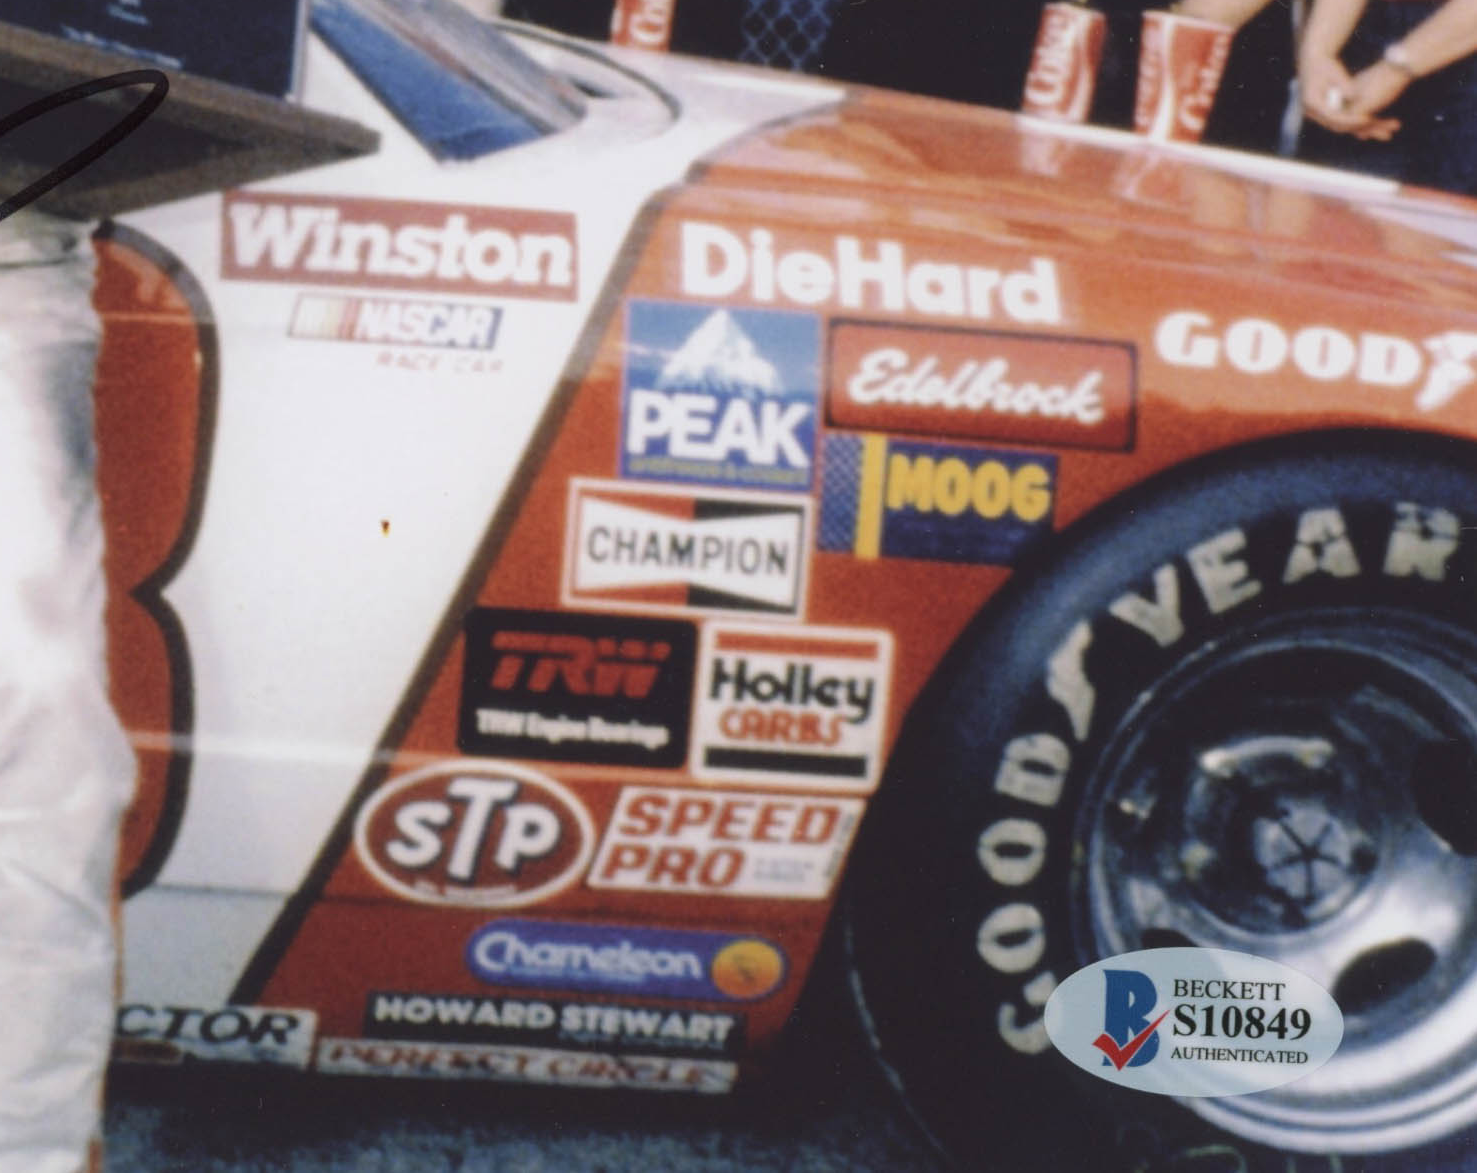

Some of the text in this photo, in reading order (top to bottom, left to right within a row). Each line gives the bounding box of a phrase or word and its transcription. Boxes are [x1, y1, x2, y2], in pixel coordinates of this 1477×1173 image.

[228, 202, 574, 287] Winston
[680, 221, 1062, 324] DieHard
[352, 300, 497, 348] NASCAR
[847, 348, 1105, 424] Edelbrock
[627, 389, 812, 469] PEAK
[886, 453, 1051, 522] MOOG
[587, 525, 789, 576] CHAMPION
[491, 631, 671, 698] TRW
[709, 657, 875, 724] Holley
[721, 709, 848, 747] CARBS
[386, 778, 561, 882] STP
[620, 792, 842, 845] SPEED
[602, 844, 746, 889] PRO
[473, 931, 704, 981] Chameleon
[374, 995, 555, 1029] HOWARD
[560, 1002, 735, 1043] STEWART
[329, 1042, 727, 1093] PERFECT CIRCLE
